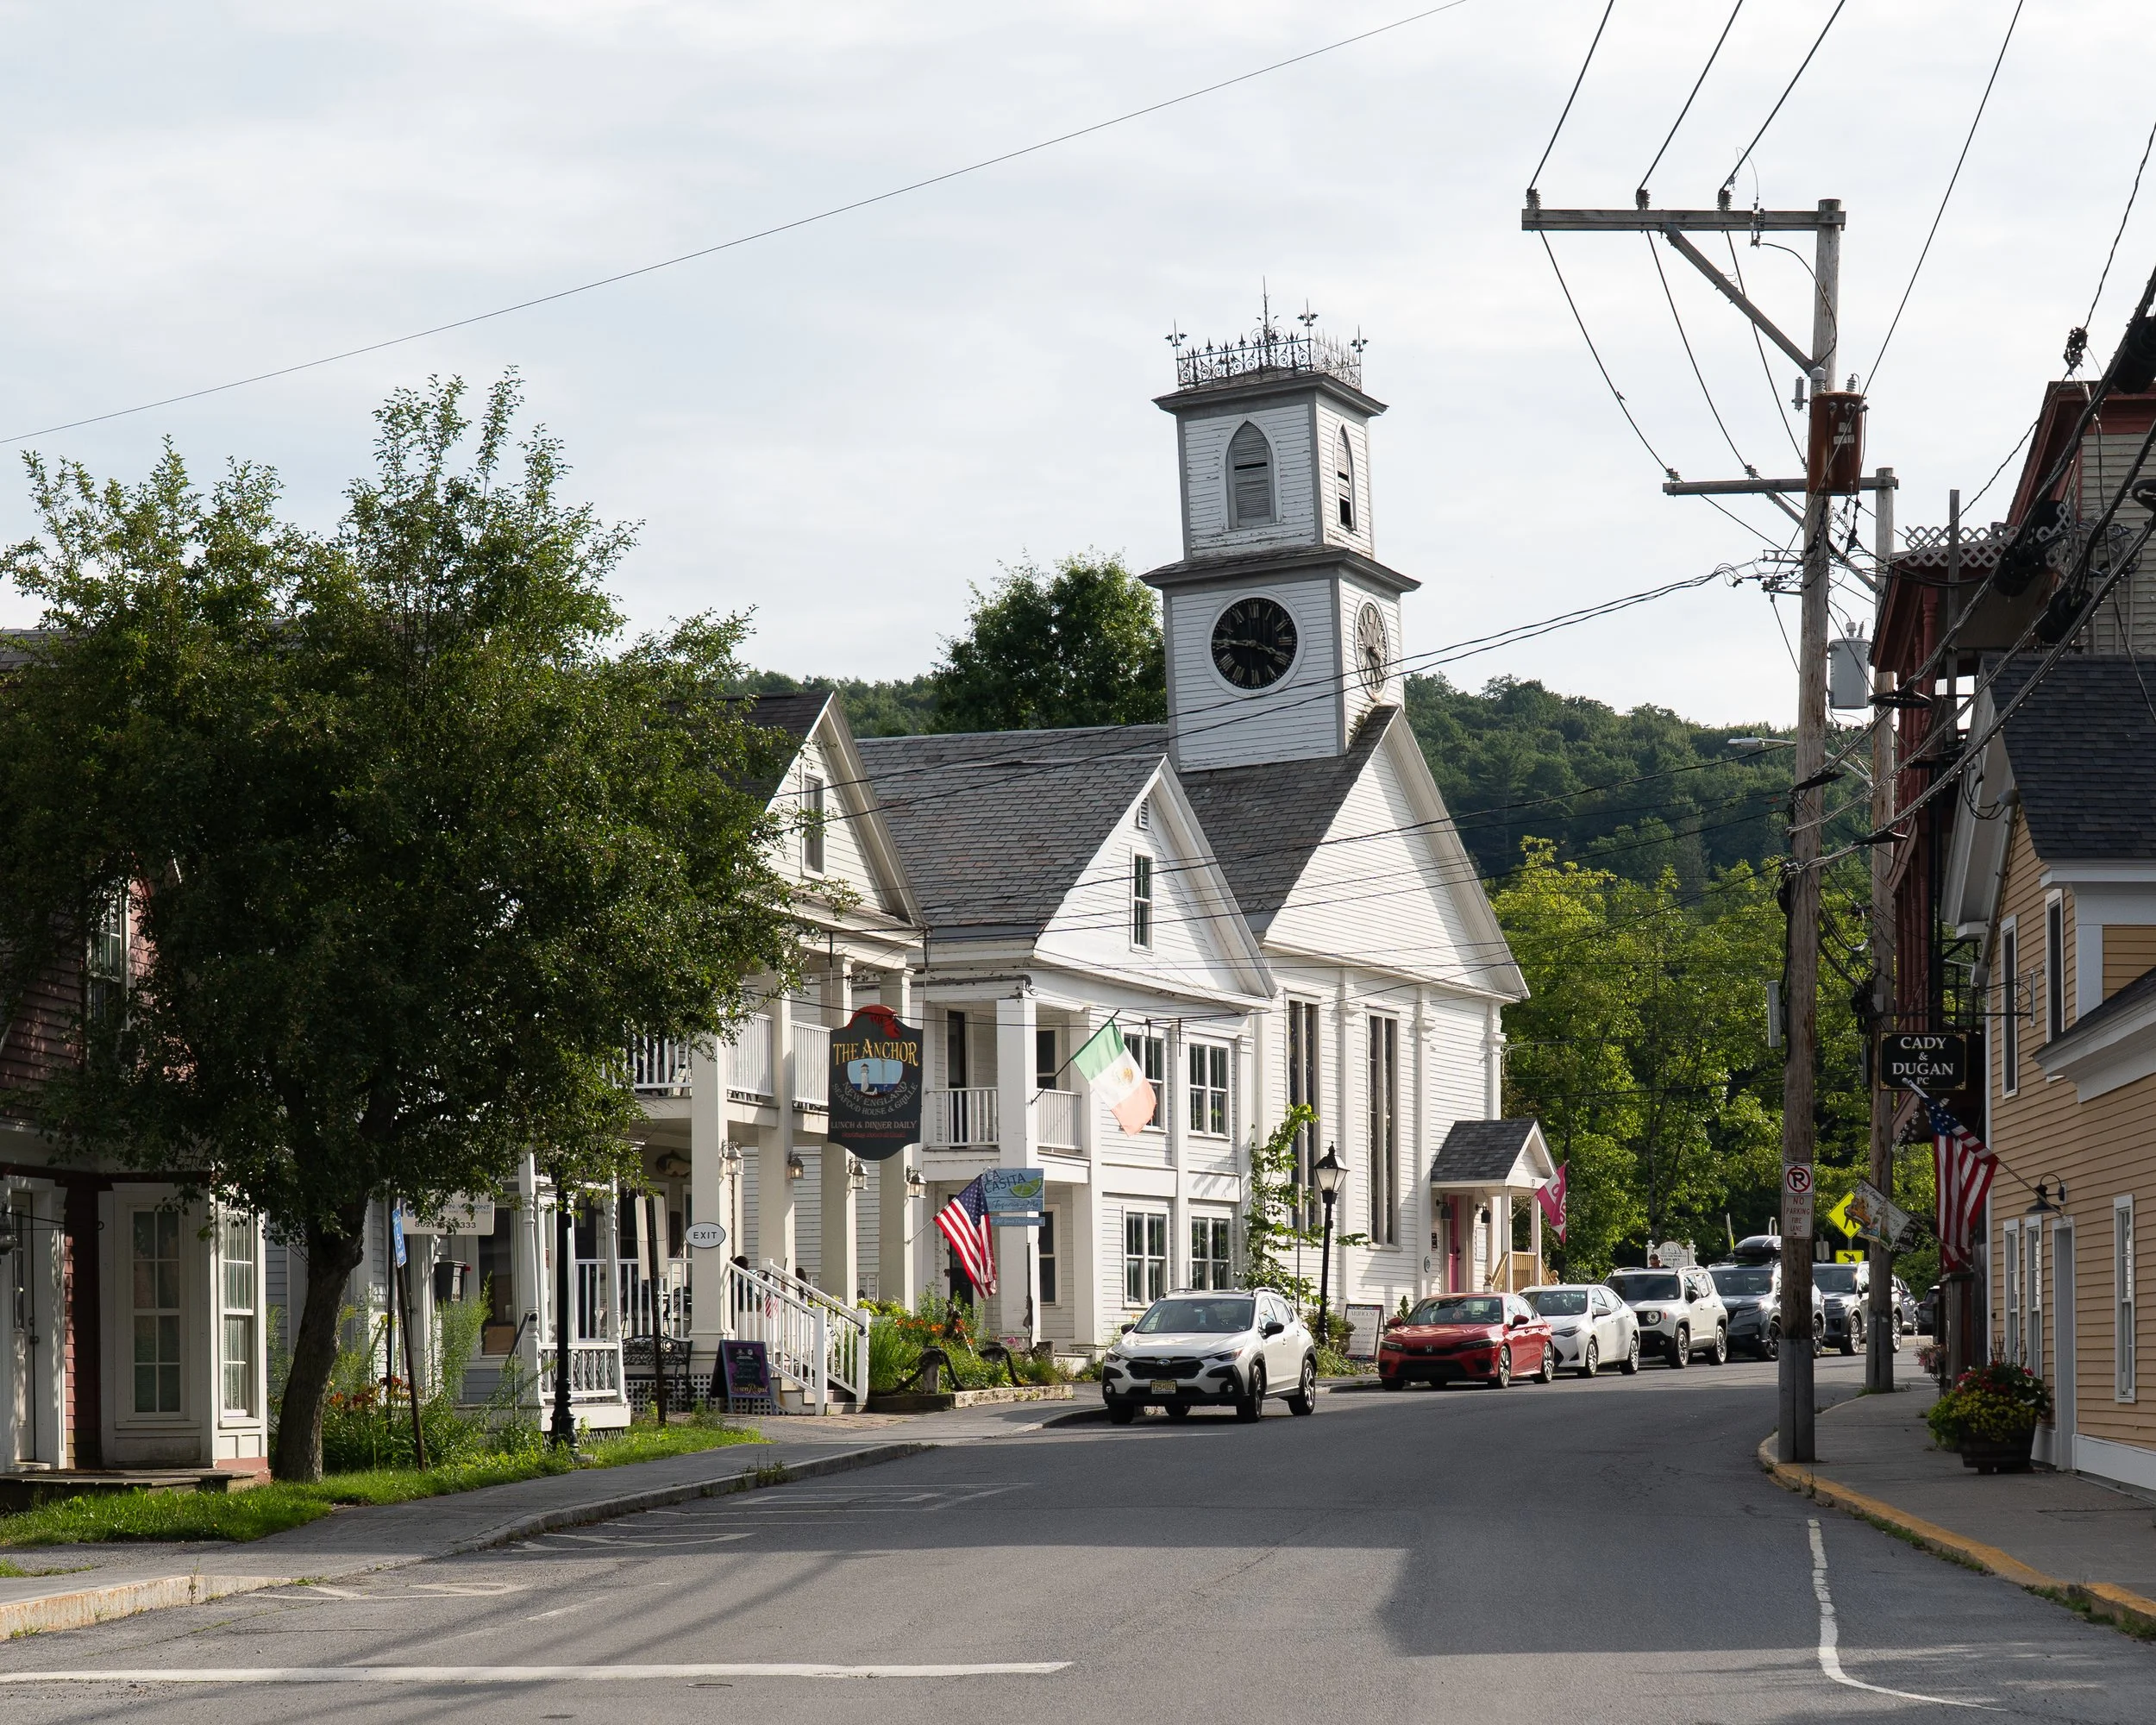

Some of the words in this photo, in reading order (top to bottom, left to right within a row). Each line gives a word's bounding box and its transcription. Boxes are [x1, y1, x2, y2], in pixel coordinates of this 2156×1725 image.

[1900, 1037, 1946, 1050] CADY
[833, 1043, 859, 1065] THE
[861, 1038, 918, 1067] ANCHOR
[1918, 1051, 1928, 1061] &
[1891, 1062, 1954, 1076] DUGAN
[1916, 1076, 1930, 1085] PC
[832, 1082, 862, 1113] SEAFOOD
[862, 1107, 887, 1116] HOUSE
[894, 1082, 918, 1109] GRILLE
[843, 1082, 862, 1102] NEW
[863, 1081, 907, 1107] ENGLAND
[830, 1120, 856, 1129] LUNCH
[864, 1120, 893, 1130] DINNER
[893, 1120, 917, 1129] DAILY
[985, 1170, 1000, 1182] LA
[984, 1172, 1026, 1194] CASITA
